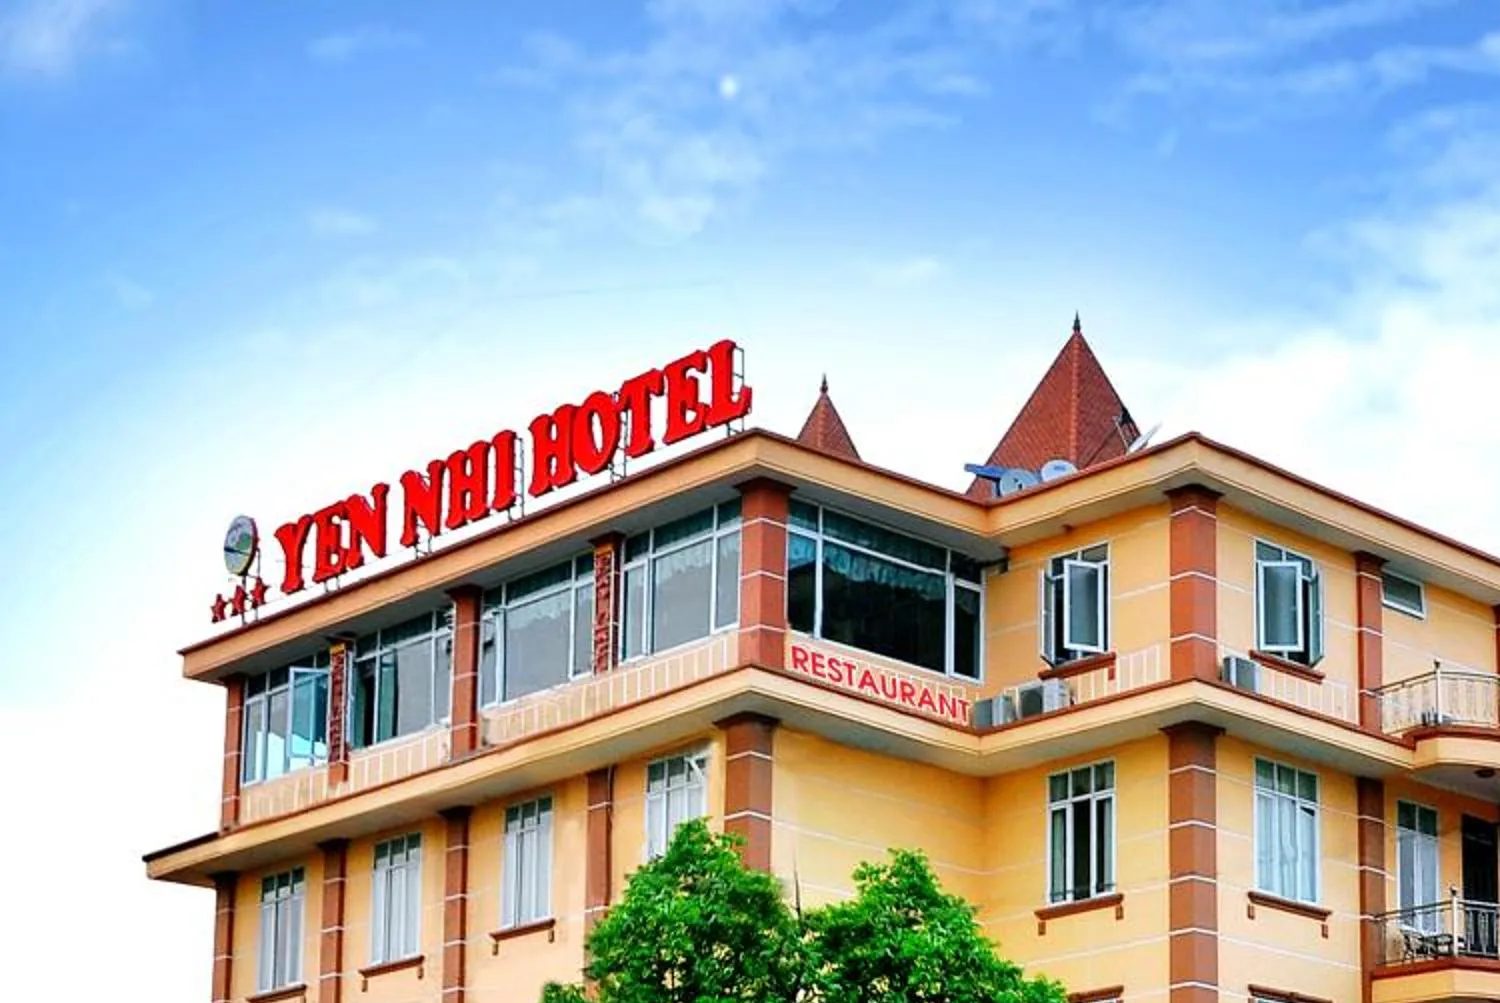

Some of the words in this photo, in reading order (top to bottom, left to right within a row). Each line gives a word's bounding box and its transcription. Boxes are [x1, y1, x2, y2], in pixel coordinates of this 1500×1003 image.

[274, 482, 389, 594] YEN
[399, 429, 518, 547] NHI
[527, 338, 754, 498] HOTEL
[791, 645, 970, 723] RESTAURANT
